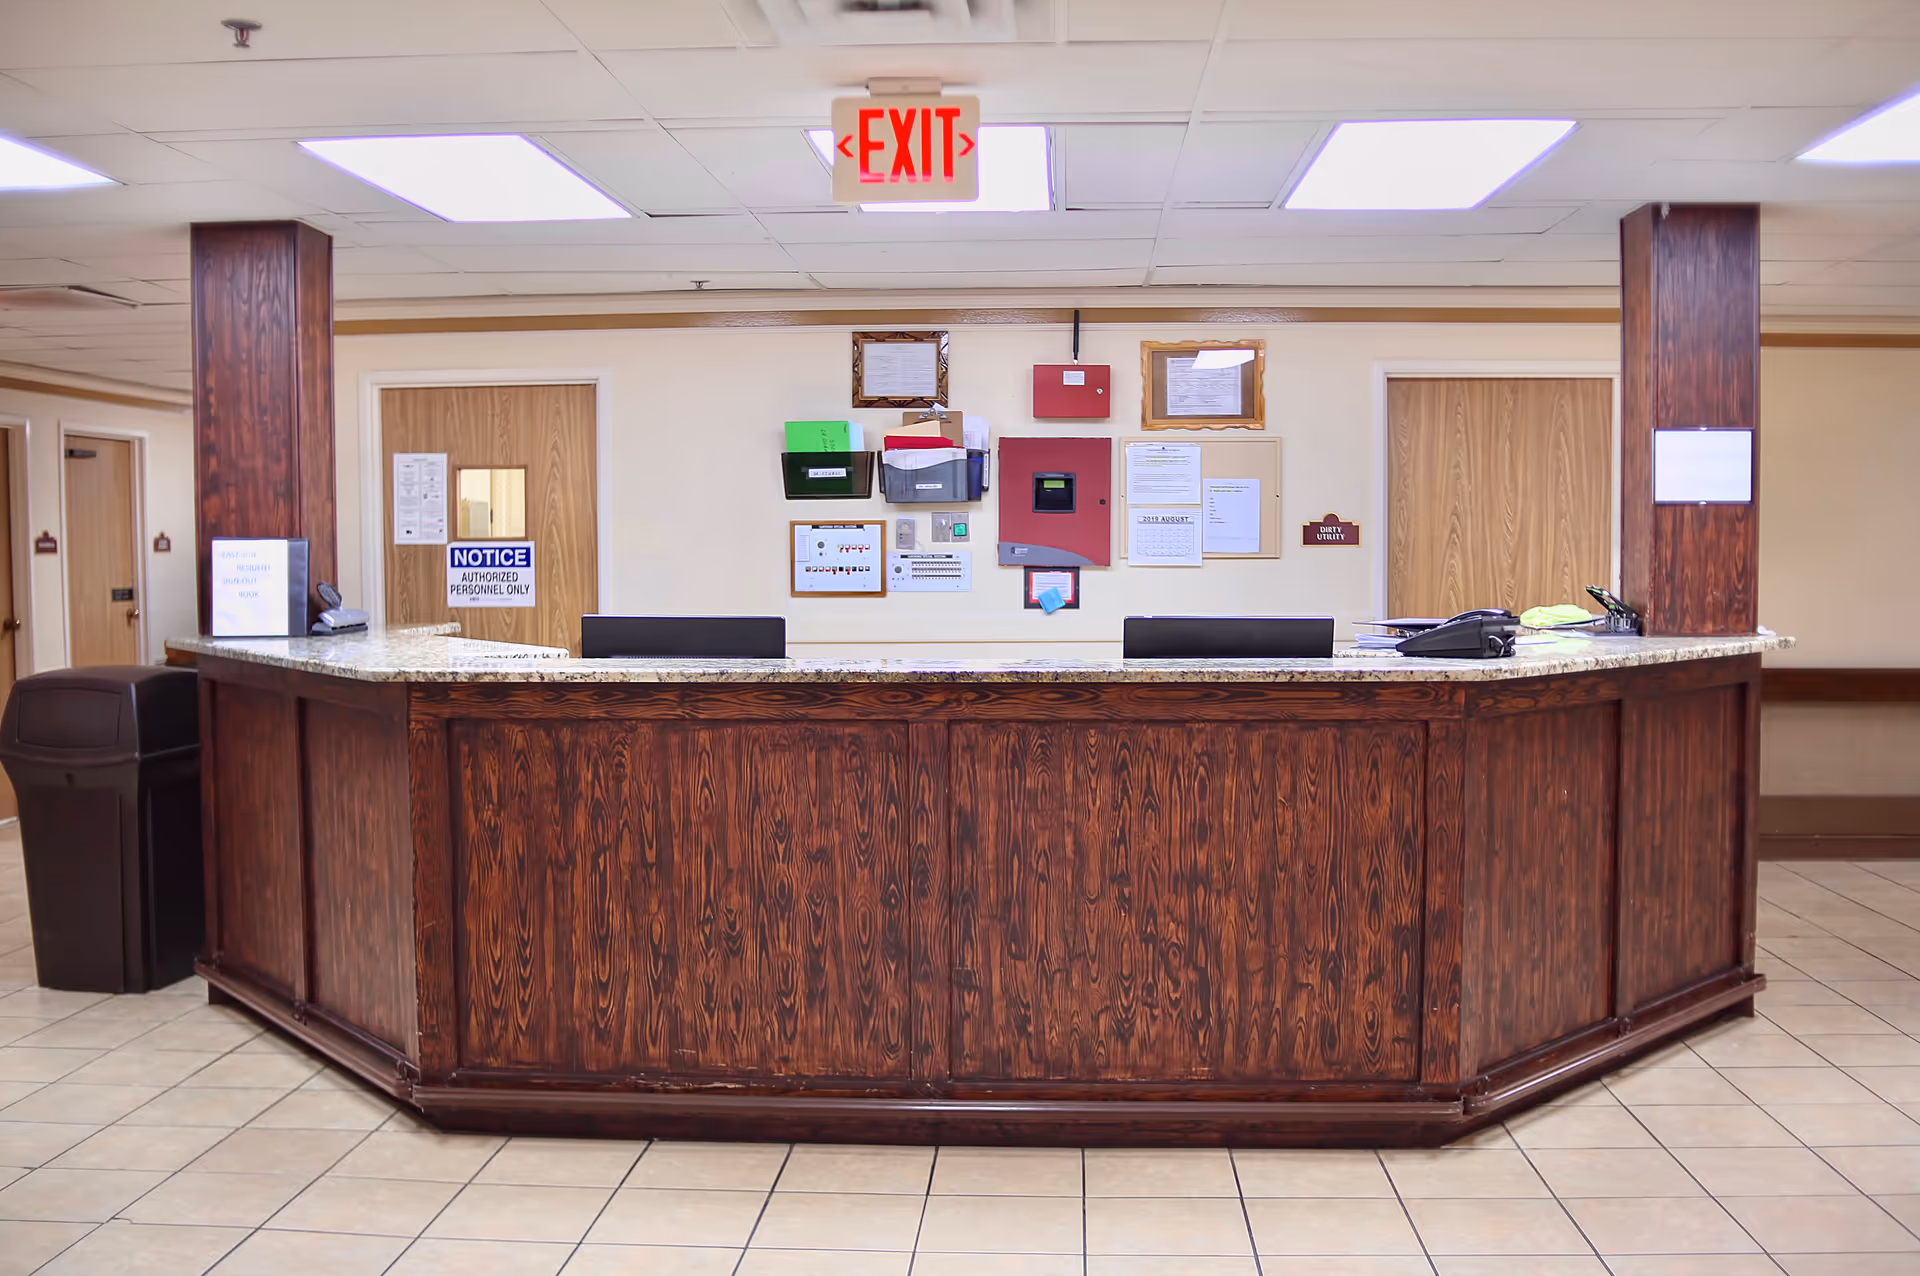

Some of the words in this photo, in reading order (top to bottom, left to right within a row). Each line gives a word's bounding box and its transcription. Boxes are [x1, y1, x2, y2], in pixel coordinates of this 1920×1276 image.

[858, 107, 961, 184] EXIT
[454, 549, 527, 566] NOTICE
[461, 571, 519, 583] AUTHORIZED
[450, 584, 505, 595] PERSONNEL
[506, 584, 530, 595] ONLY
